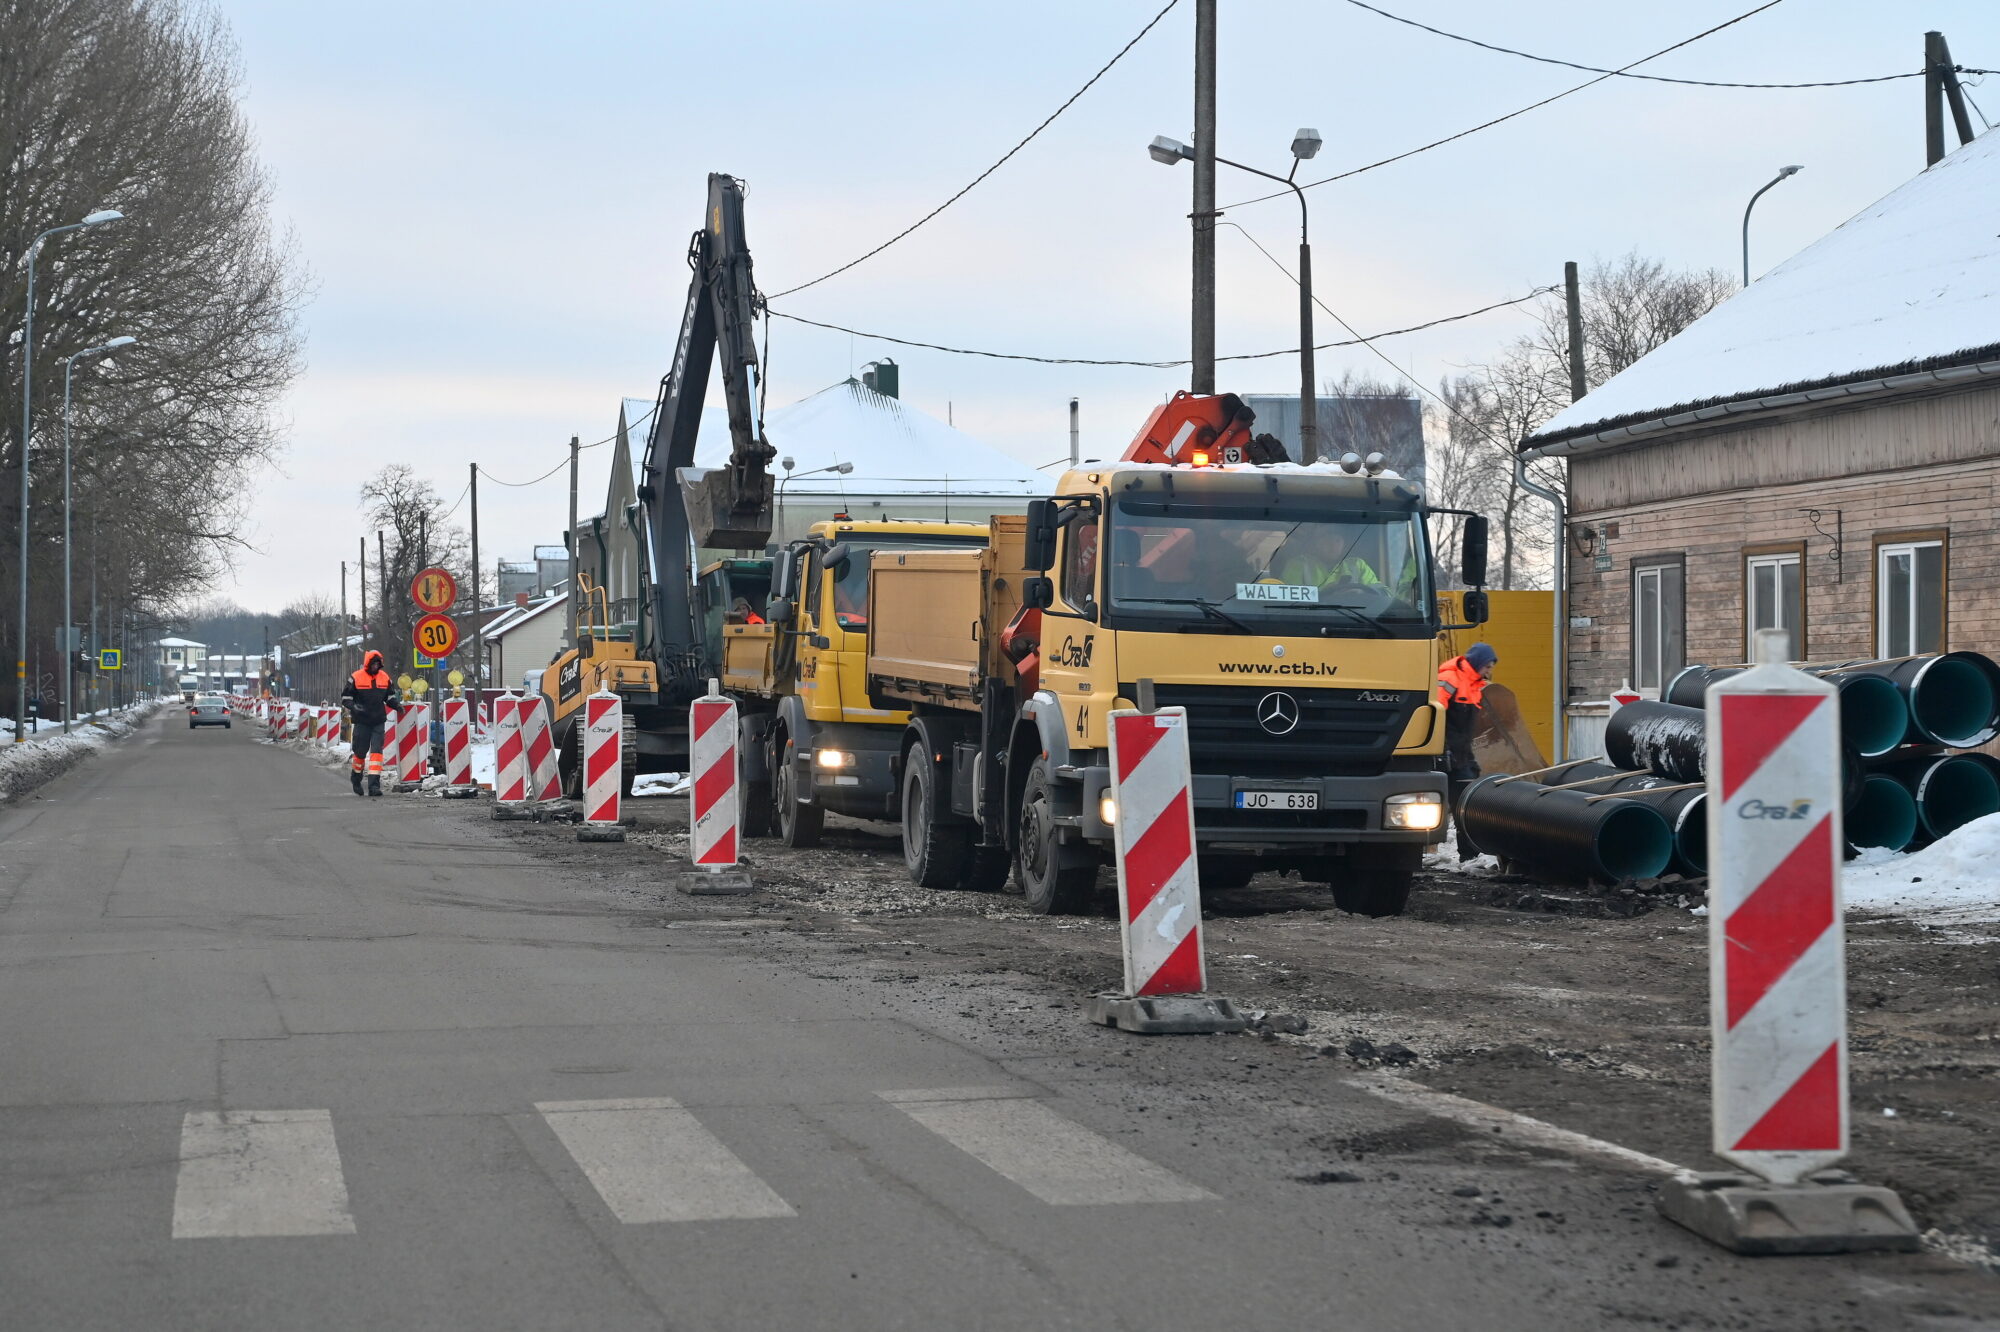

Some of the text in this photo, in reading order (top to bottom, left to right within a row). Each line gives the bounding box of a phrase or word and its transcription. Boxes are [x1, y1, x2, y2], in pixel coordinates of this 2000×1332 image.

[671, 297, 695, 399] VOLVO
[1244, 585, 1311, 601] WALTER
[424, 624, 447, 648] 30
[1218, 662, 1338, 676] www.ctb.lv
[1076, 704, 1089, 739] 41
[1287, 794, 1316, 808] 638
